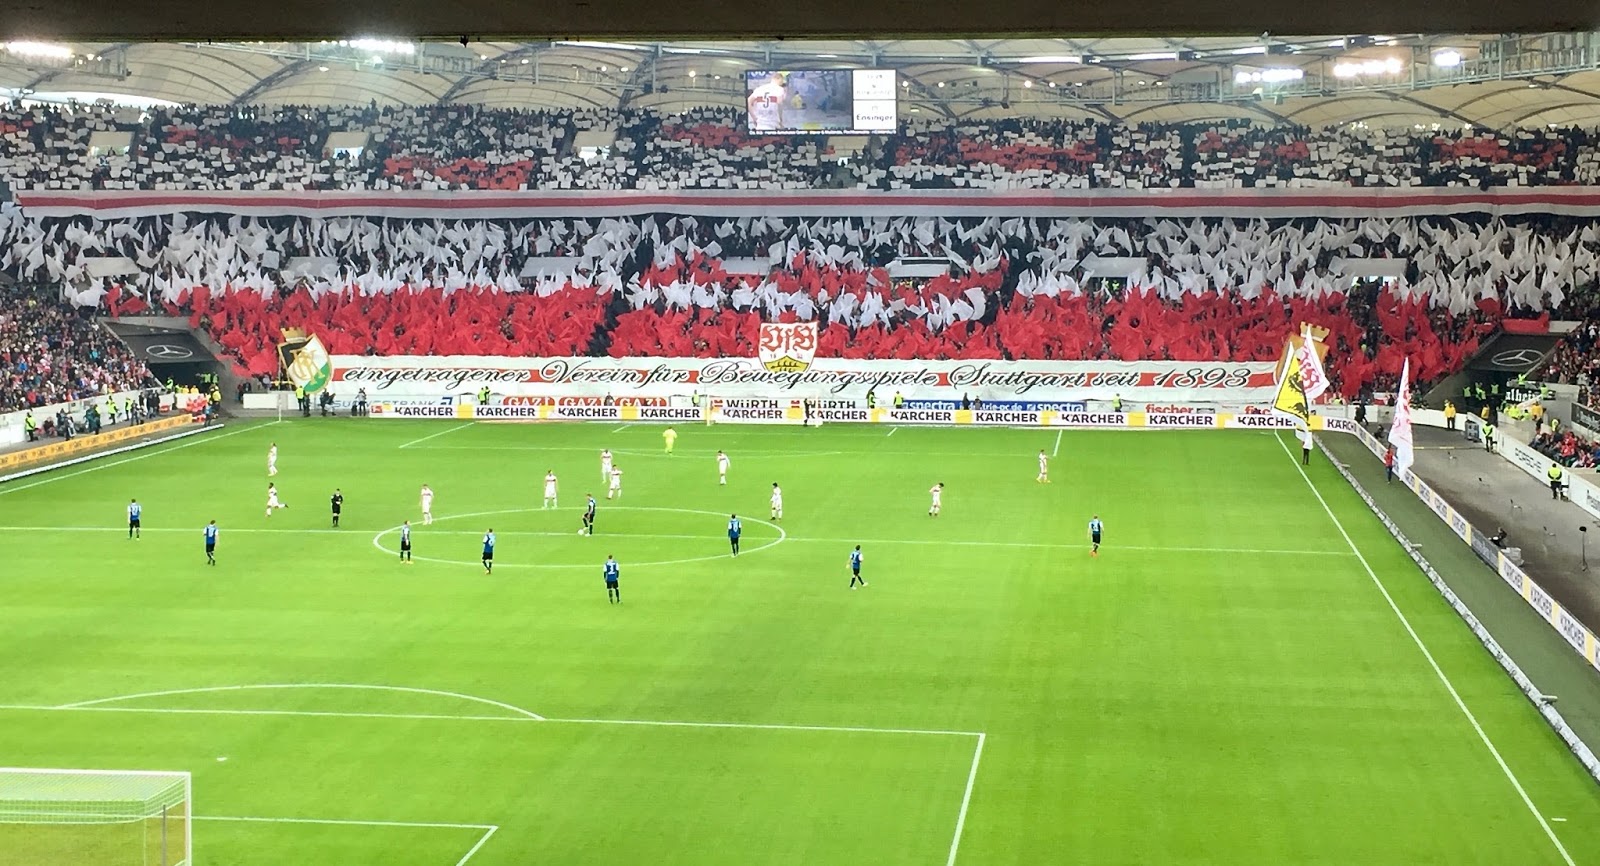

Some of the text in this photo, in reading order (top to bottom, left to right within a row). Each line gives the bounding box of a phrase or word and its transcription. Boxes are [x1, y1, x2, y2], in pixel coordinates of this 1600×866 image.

[763, 92, 770, 108] 5
[344, 367, 529, 390] eingetragener
[540, 360, 642, 383] Verein
[633, 363, 688, 389] für
[700, 360, 939, 393] Bewegungsspiele
[950, 362, 1087, 394] Stuttgart
[1092, 371, 1140, 386] seit
[1154, 368, 1251, 387] 1893
[476, 407, 535, 416] KÄRCHER
[640, 408, 700, 418] KÄRCHER
[976, 412, 1038, 422] KÄRCHER
[1150, 415, 1213, 425] KÄRCHER
[1238, 416, 1297, 426] KÄRCHE
